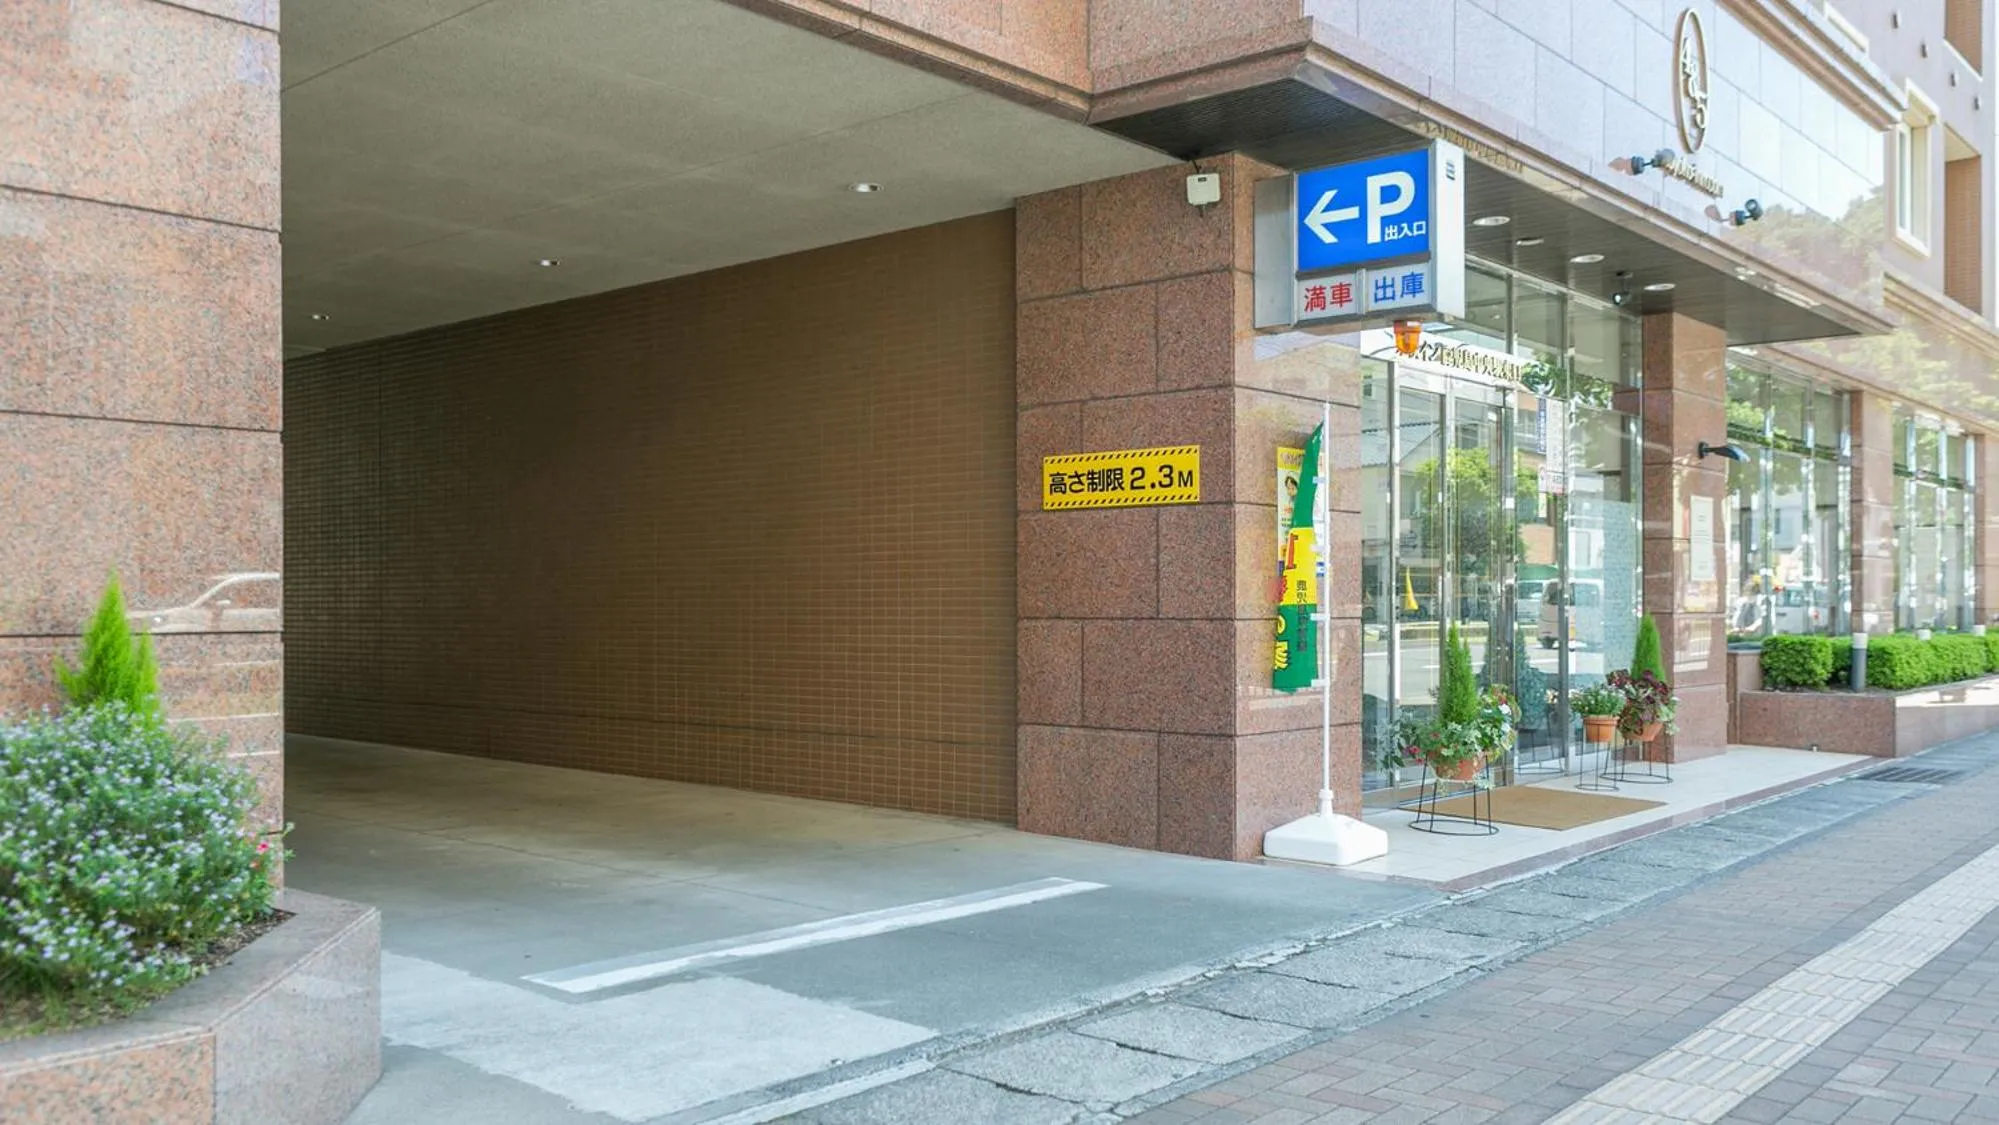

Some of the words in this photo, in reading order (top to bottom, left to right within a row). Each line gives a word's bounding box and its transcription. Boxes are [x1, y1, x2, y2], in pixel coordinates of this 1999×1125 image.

[1366, 171, 1415, 244] P
[1384, 221, 1427, 241] 出入口
[1304, 282, 1353, 312] 満車
[1374, 272, 1425, 303] 出庫
